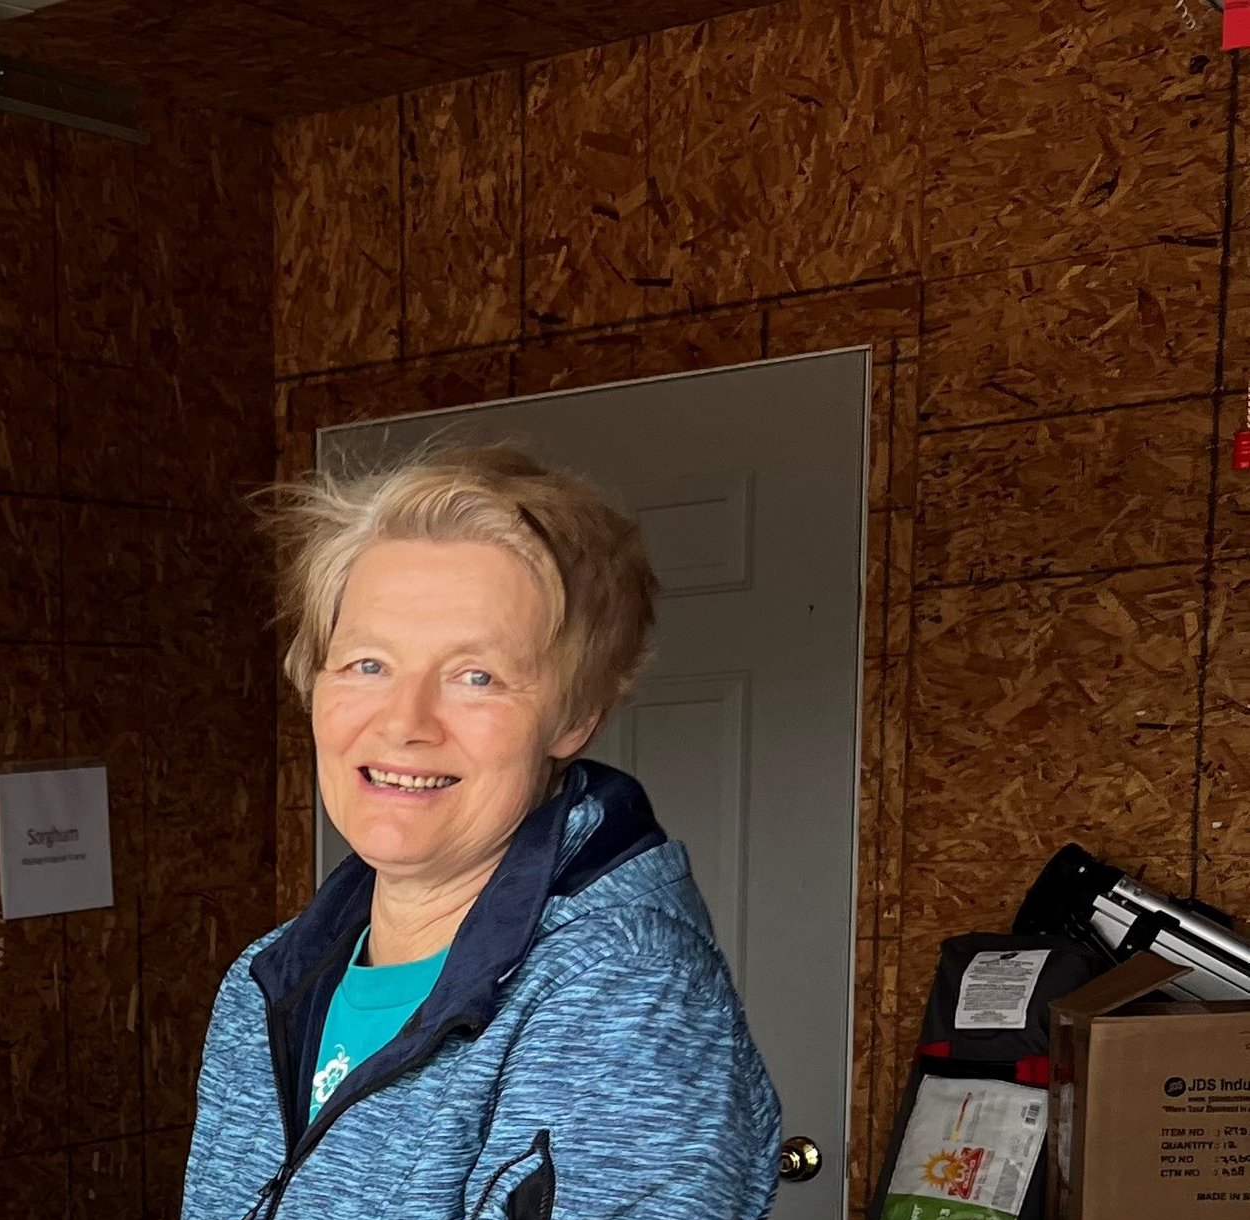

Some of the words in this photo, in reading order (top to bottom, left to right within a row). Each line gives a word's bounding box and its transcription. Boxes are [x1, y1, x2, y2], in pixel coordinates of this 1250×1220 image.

[1188, 1079, 1216, 1092] JDS
[1160, 1128, 1186, 1137] ITEM
[1189, 1128, 1204, 1136] NO
[1160, 1141, 1213, 1150] QUANTITY
[1178, 1155, 1194, 1163] NO
[1184, 1169, 1200, 1177] NO
[1197, 1193, 1227, 1201] MADE
[1229, 1193, 1240, 1201] IN
